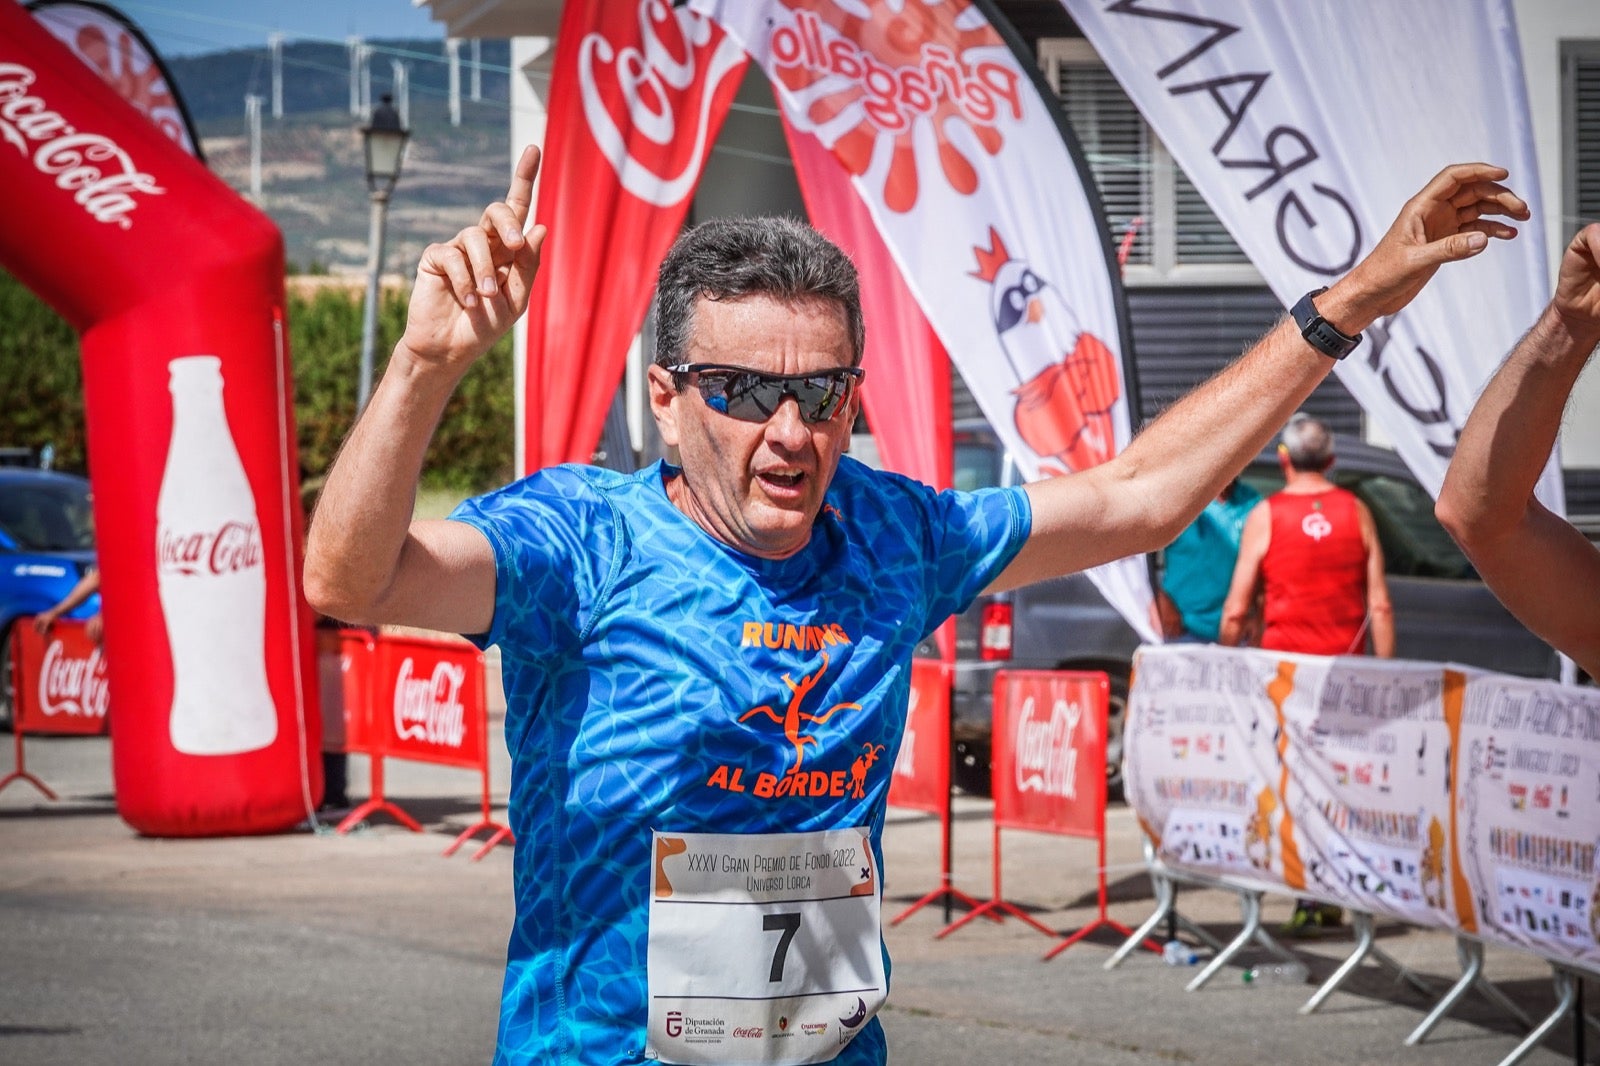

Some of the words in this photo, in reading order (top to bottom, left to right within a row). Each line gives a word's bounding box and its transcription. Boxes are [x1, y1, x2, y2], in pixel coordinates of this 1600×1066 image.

[707, 765, 745, 792] AL
[753, 771, 846, 798] BORDE
[688, 853, 718, 873] XXXV
[833, 848, 855, 868] 2022
[763, 912, 801, 983] 7
[685, 1017, 725, 1027] Diputación
[685, 1027, 694, 1035] de
[694, 1027, 725, 1035] Granada
